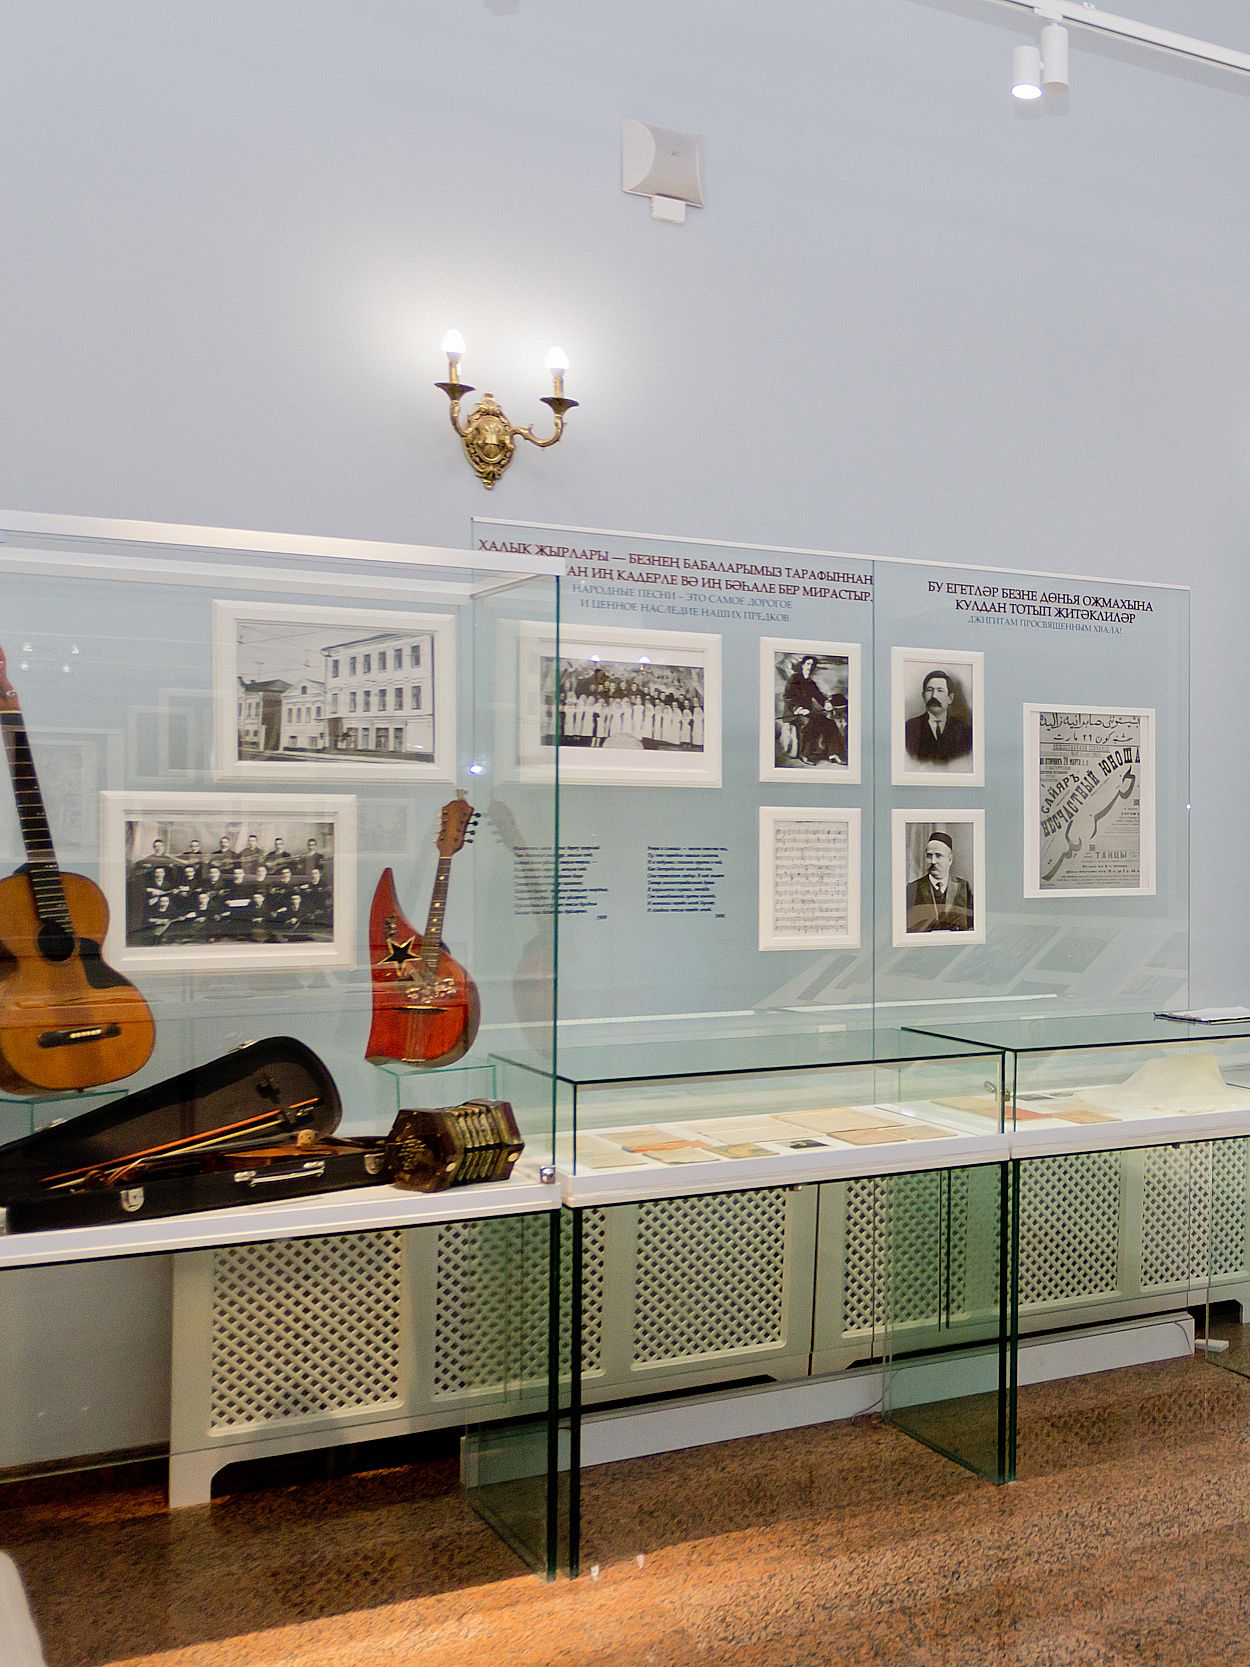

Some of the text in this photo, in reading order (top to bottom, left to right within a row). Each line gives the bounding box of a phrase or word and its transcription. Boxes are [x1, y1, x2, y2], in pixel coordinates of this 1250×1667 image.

[479, 539, 874, 585] ХАЛЫК ЖЫРЛАРЫ БЕЗНЕҢ БАБАЛАРЫМЫЗ ТАРАФЫННАН
[572, 583, 793, 609] НАРОДНЫЕ ПЕСНИ ЭТО САМОЕ ДОРОГОЕ
[592, 567, 614, 582] ИҢ
[616, 570, 678, 586] КАДЕРЛЕ
[681, 576, 698, 587] ВӘ
[701, 577, 722, 592] ИҢ
[778, 583, 800, 596] БЕР
[802, 585, 873, 602] МИРАСТЫР.
[927, 580, 1154, 612] БУ ЕГЕТЛӘР БЕЗНЕ ДӨНЬЯ ОҖМАХЫНА
[580, 598, 589, 607] И
[592, 600, 638, 612] ЦЕННОЕ
[640, 603, 699, 616] НАСЛЕДИЕ
[701, 607, 742, 619] НАШИХ
[955, 599, 1137, 624] КУЛДАН ТОТЫП ҖИТӘКЛИЛӘР
[967, 615, 1018, 627] ДЖИГИТАМ
[1041, 746, 1141, 838] НЕСЧАСТНЫЙ ЮНОША
[1041, 773, 1080, 814] САЙЯРЪ
[1095, 850, 1128, 860] ТАНЦЫ
